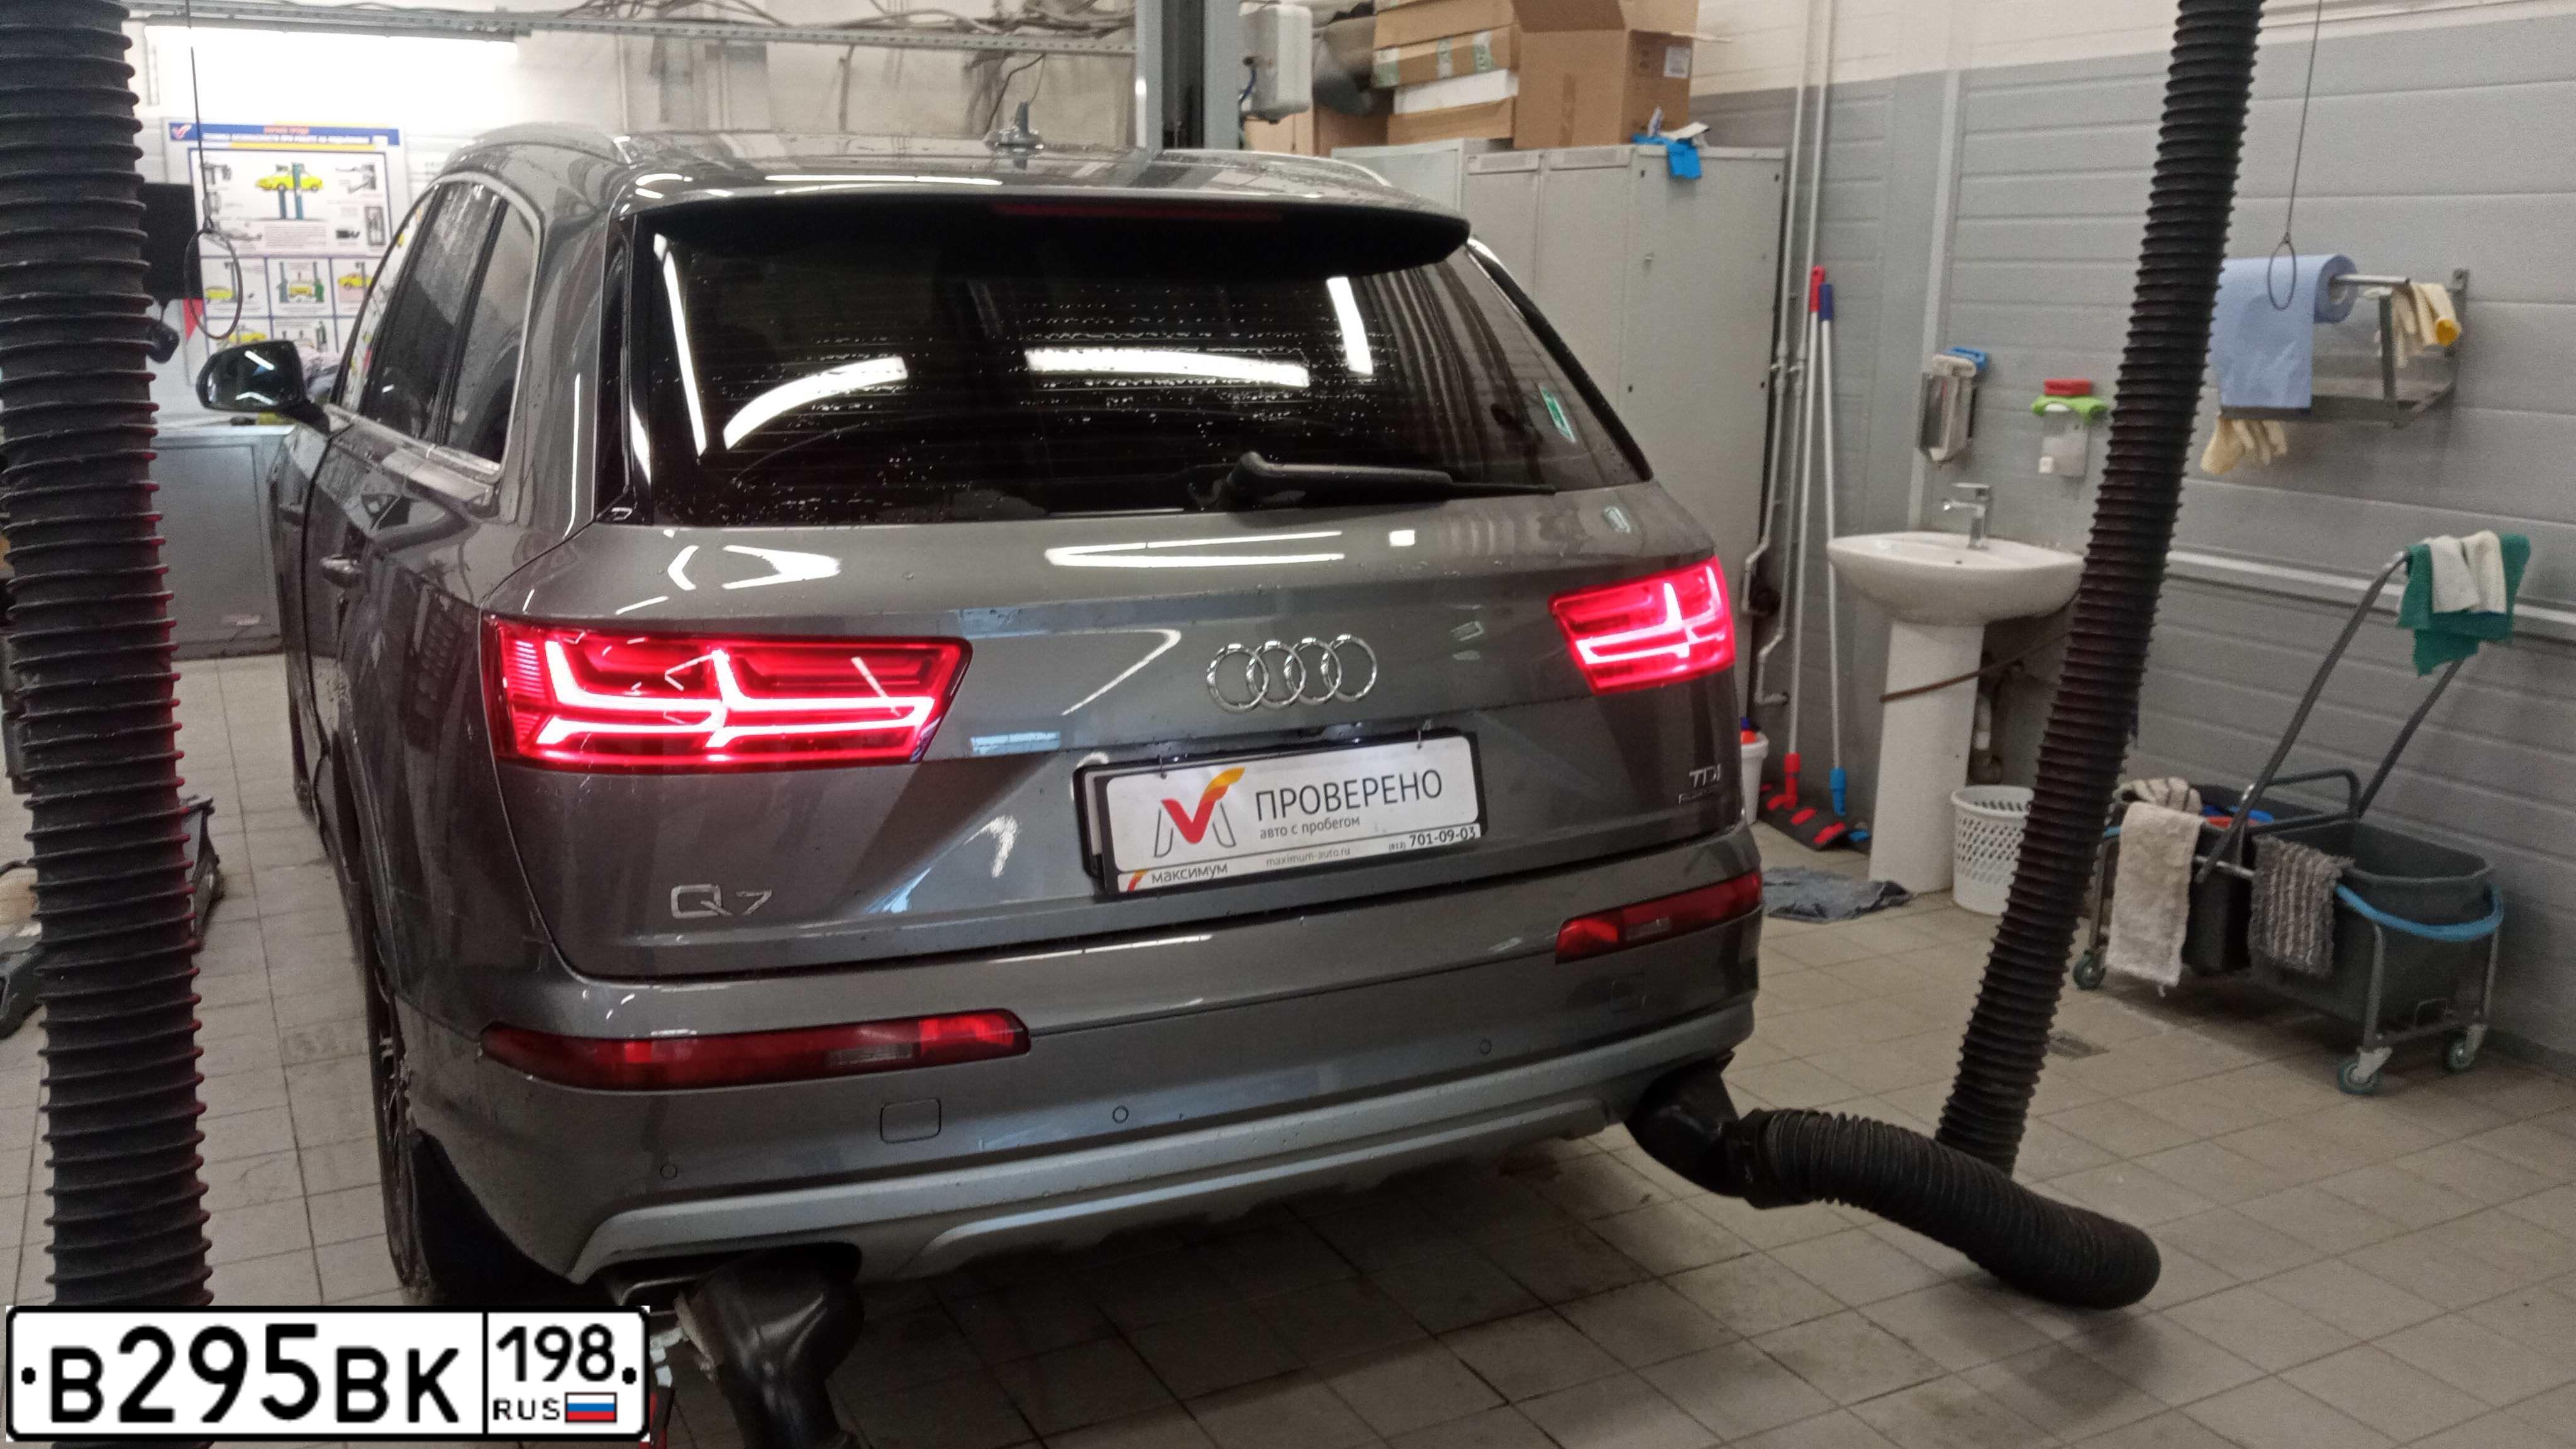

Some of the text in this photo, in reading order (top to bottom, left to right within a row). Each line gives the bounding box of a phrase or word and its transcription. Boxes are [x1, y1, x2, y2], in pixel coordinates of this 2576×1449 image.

[1689, 763, 1721, 788] TDI
[1255, 768, 1443, 821] ПРОВЕРЕНО
[1260, 815, 1360, 839] авто с пробегом
[1409, 826, 1476, 847] 701-09-03
[1266, 847, 1351, 867] maximum-auto.ru
[1152, 863, 1228, 884] максимум
